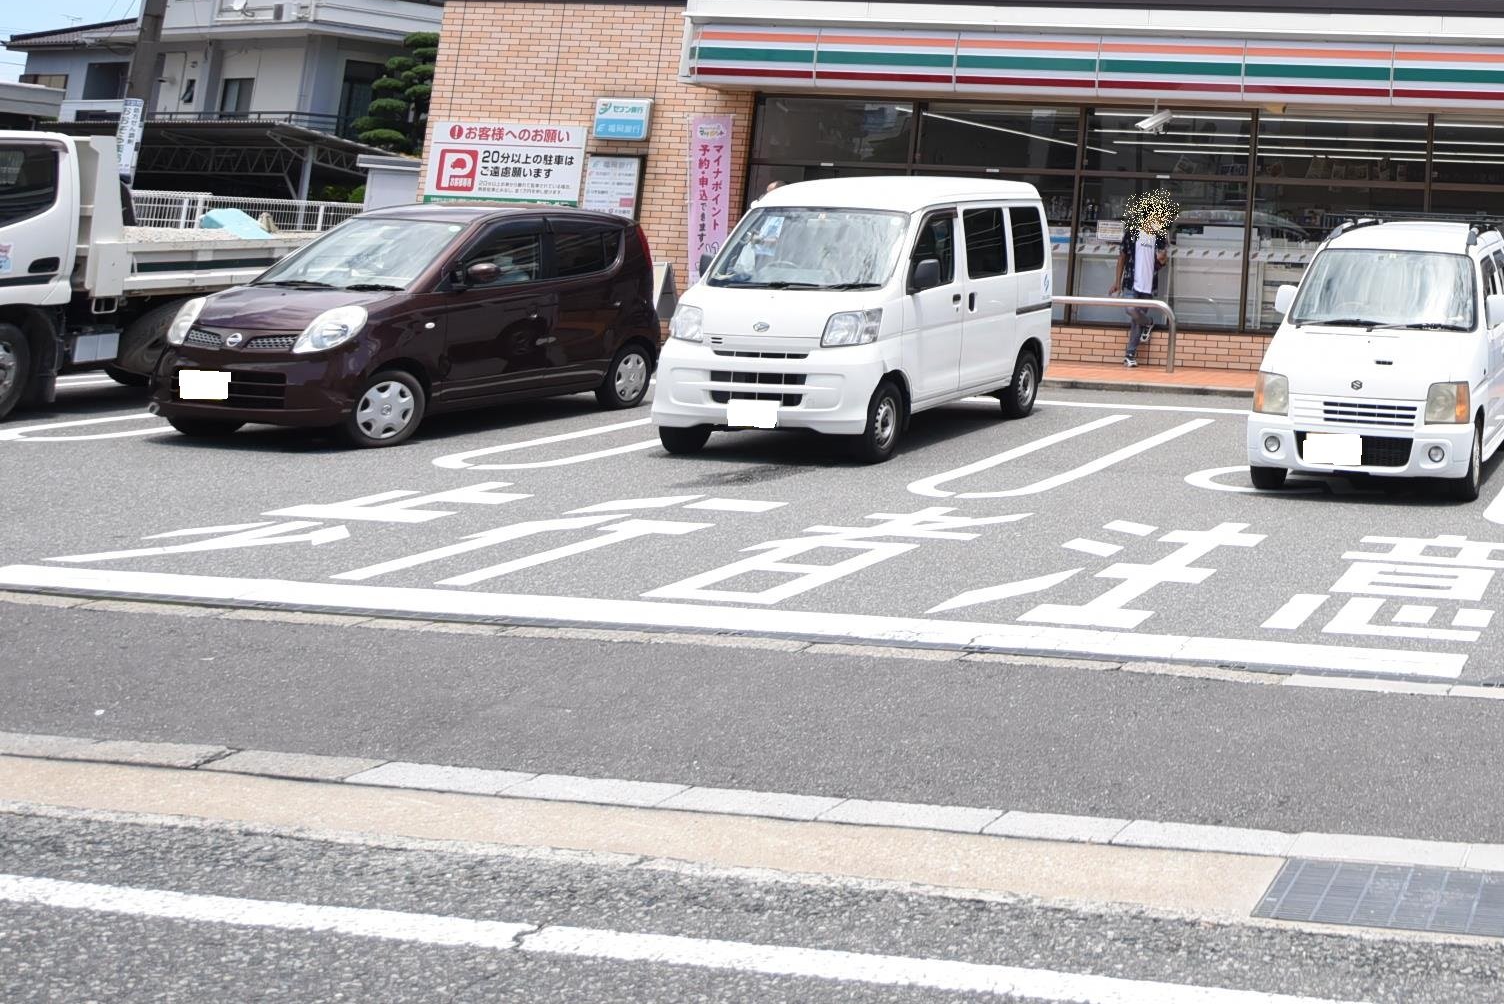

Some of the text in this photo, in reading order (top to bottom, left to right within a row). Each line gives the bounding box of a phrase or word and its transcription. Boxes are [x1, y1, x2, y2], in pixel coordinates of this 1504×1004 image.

[465, 127, 570, 143] お客様へのお願い
[481, 150, 575, 166] 20分以上の駐車は
[480, 166, 553, 179] ご遠慮願います
[711, 145, 724, 231] マイナポイント
